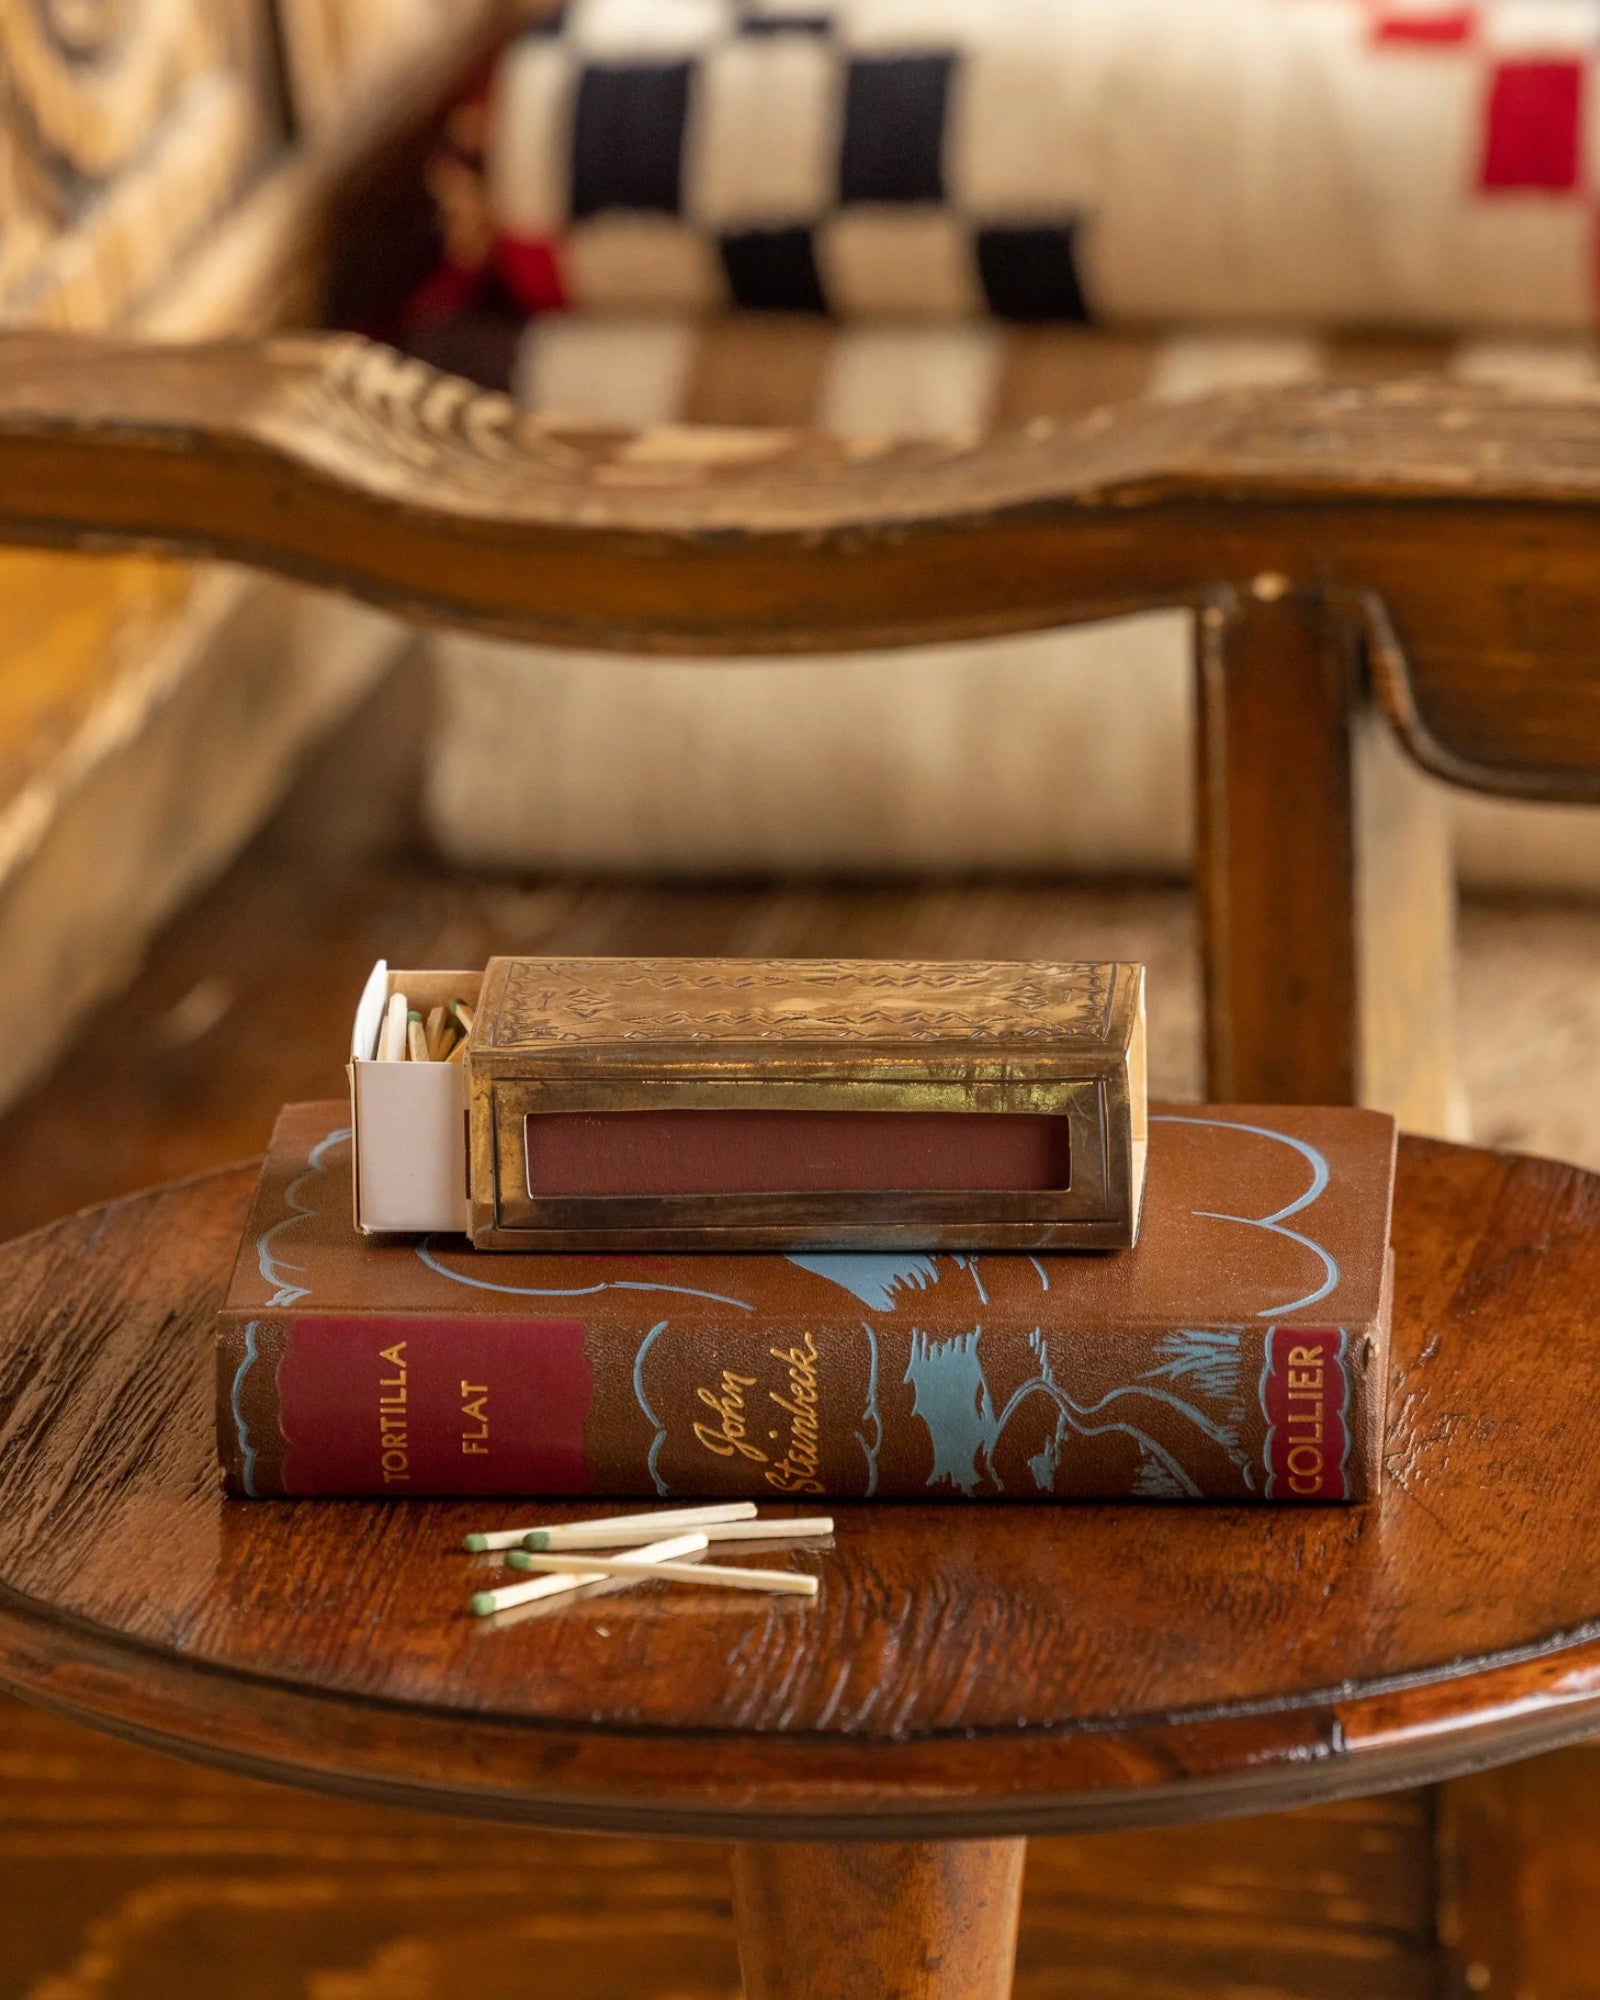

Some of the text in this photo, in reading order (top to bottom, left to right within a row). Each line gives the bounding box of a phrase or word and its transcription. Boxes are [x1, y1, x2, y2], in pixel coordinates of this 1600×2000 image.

[380, 1341, 409, 1484] TORTILLA
[461, 1380, 489, 1455] FLAT
[693, 1370, 769, 1462] John
[764, 1331, 825, 1494] Steinbeck
[1287, 1344, 1324, 1495] COLLIER
